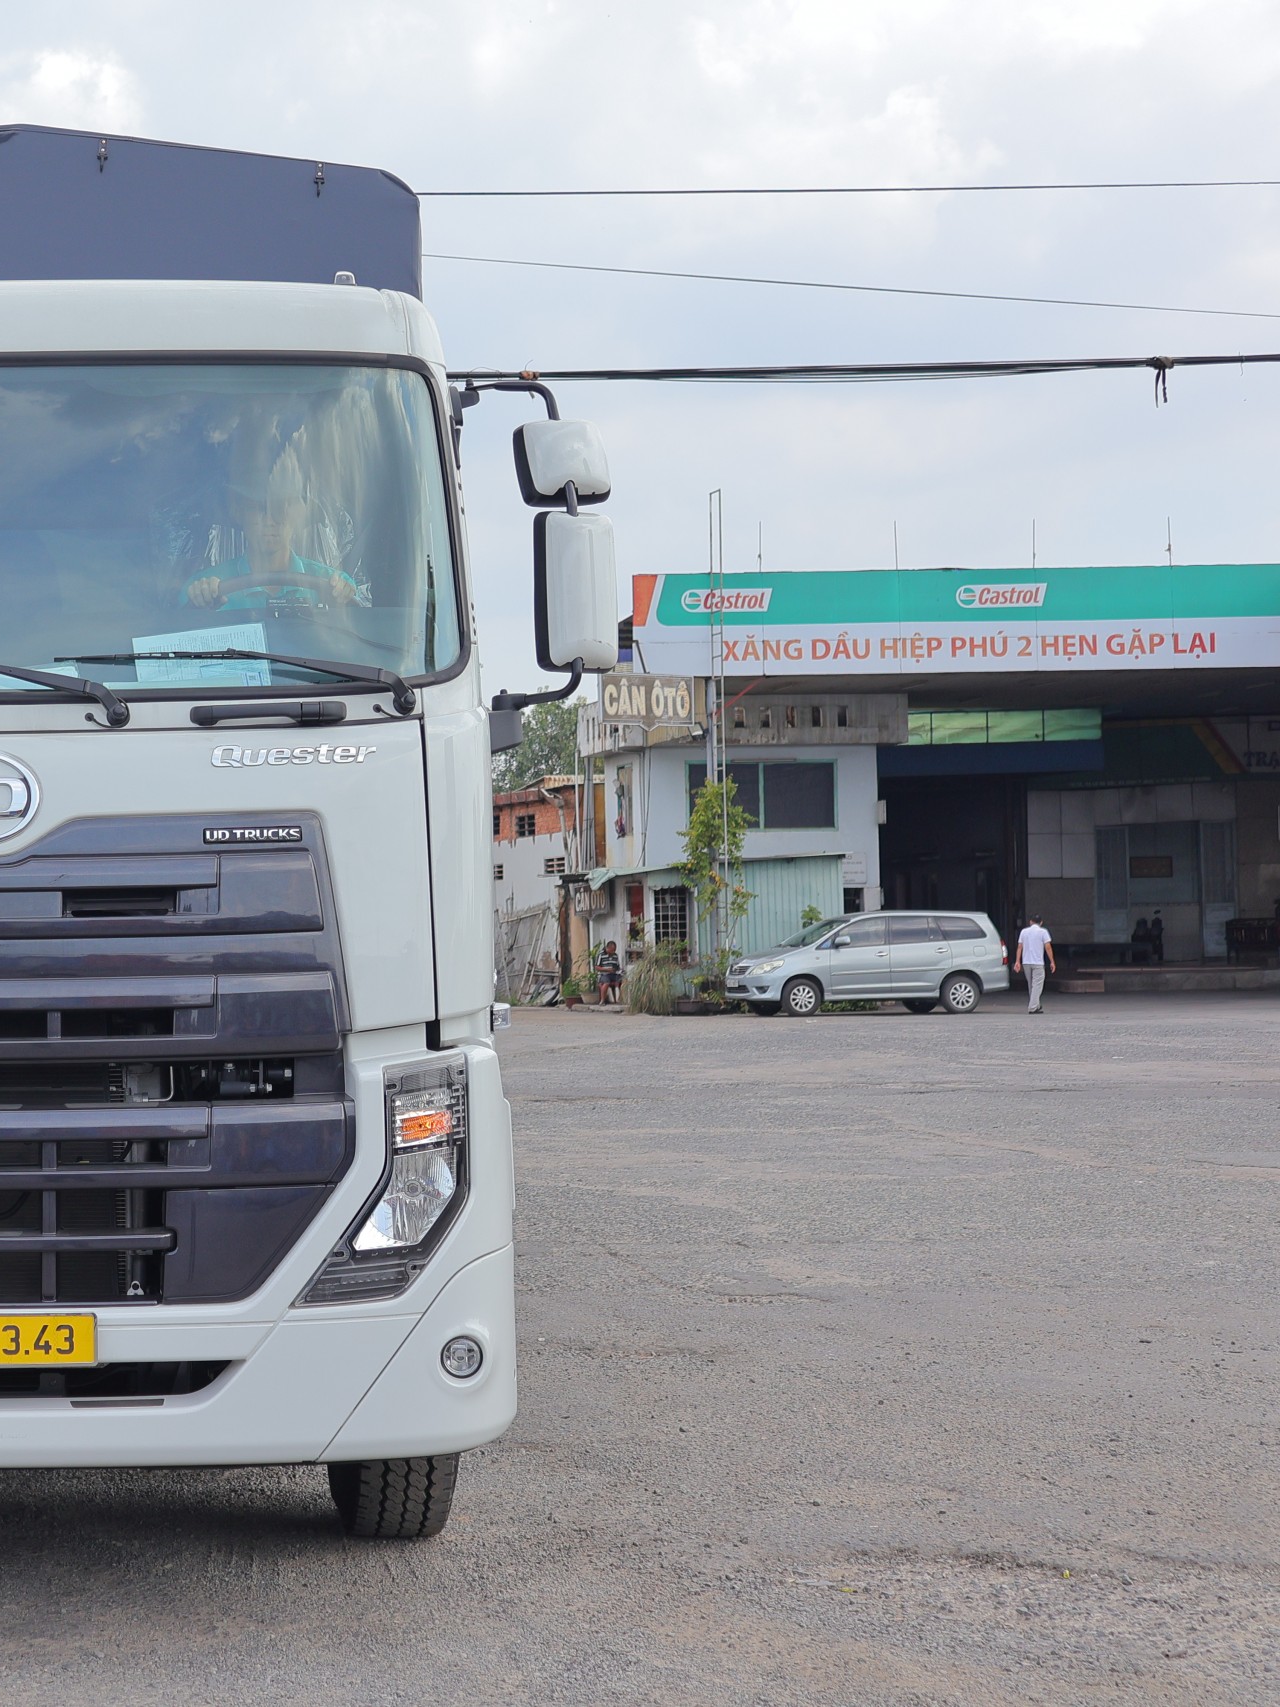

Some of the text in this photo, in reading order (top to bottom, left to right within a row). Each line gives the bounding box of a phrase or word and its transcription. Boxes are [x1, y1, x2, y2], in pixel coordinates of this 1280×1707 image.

[702, 588, 767, 611] Castrol
[978, 585, 1041, 606] Castrol
[722, 627, 1216, 664] XĂNG DẦU HIỆP PHÚ 2 HẸN GẶP LẠI
[604, 677, 690, 718] CÂN ÔTÔ
[210, 743, 377, 769] Quester
[206, 828, 301, 842] UD TRUCKS
